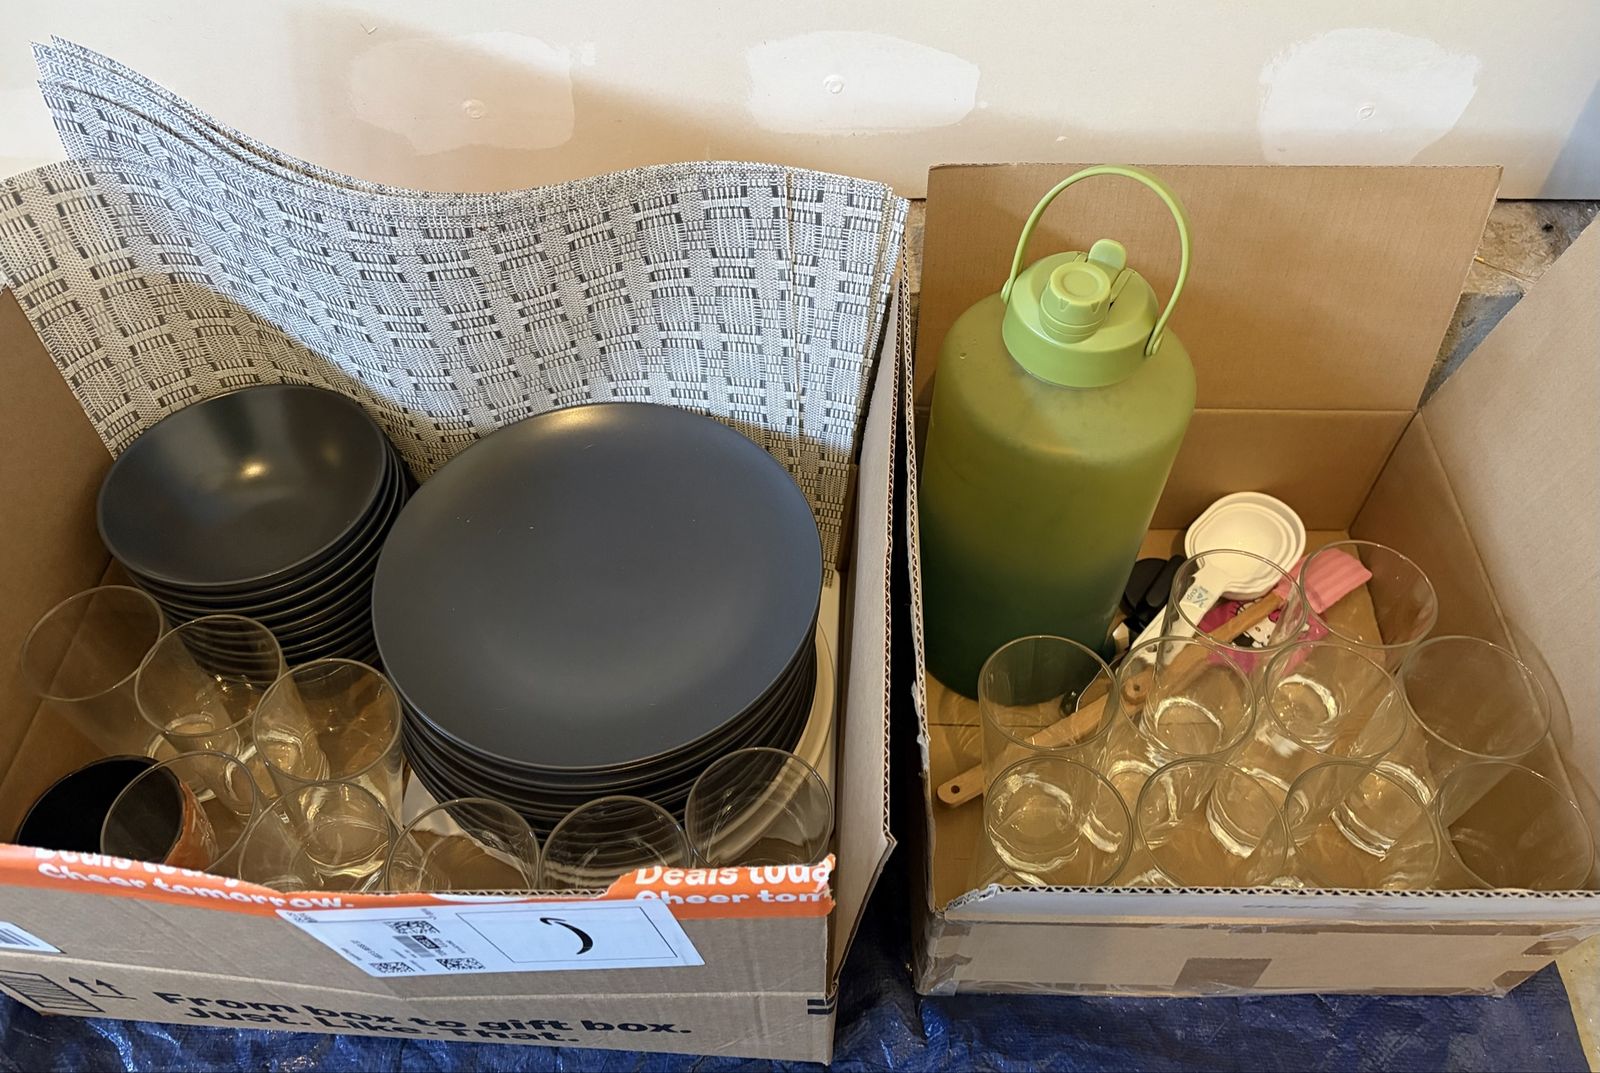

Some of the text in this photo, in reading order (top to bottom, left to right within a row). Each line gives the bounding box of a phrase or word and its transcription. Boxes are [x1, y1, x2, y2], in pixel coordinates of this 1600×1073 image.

[38, 863, 148, 889] Cheer
[153, 877, 354, 908] tomorrow.
[635, 865, 738, 885] Deals
[634, 889, 749, 904] Cheer
[152, 991, 692, 1033] From box to gift box.
[184, 1007, 579, 1042] Just. Like. That.
